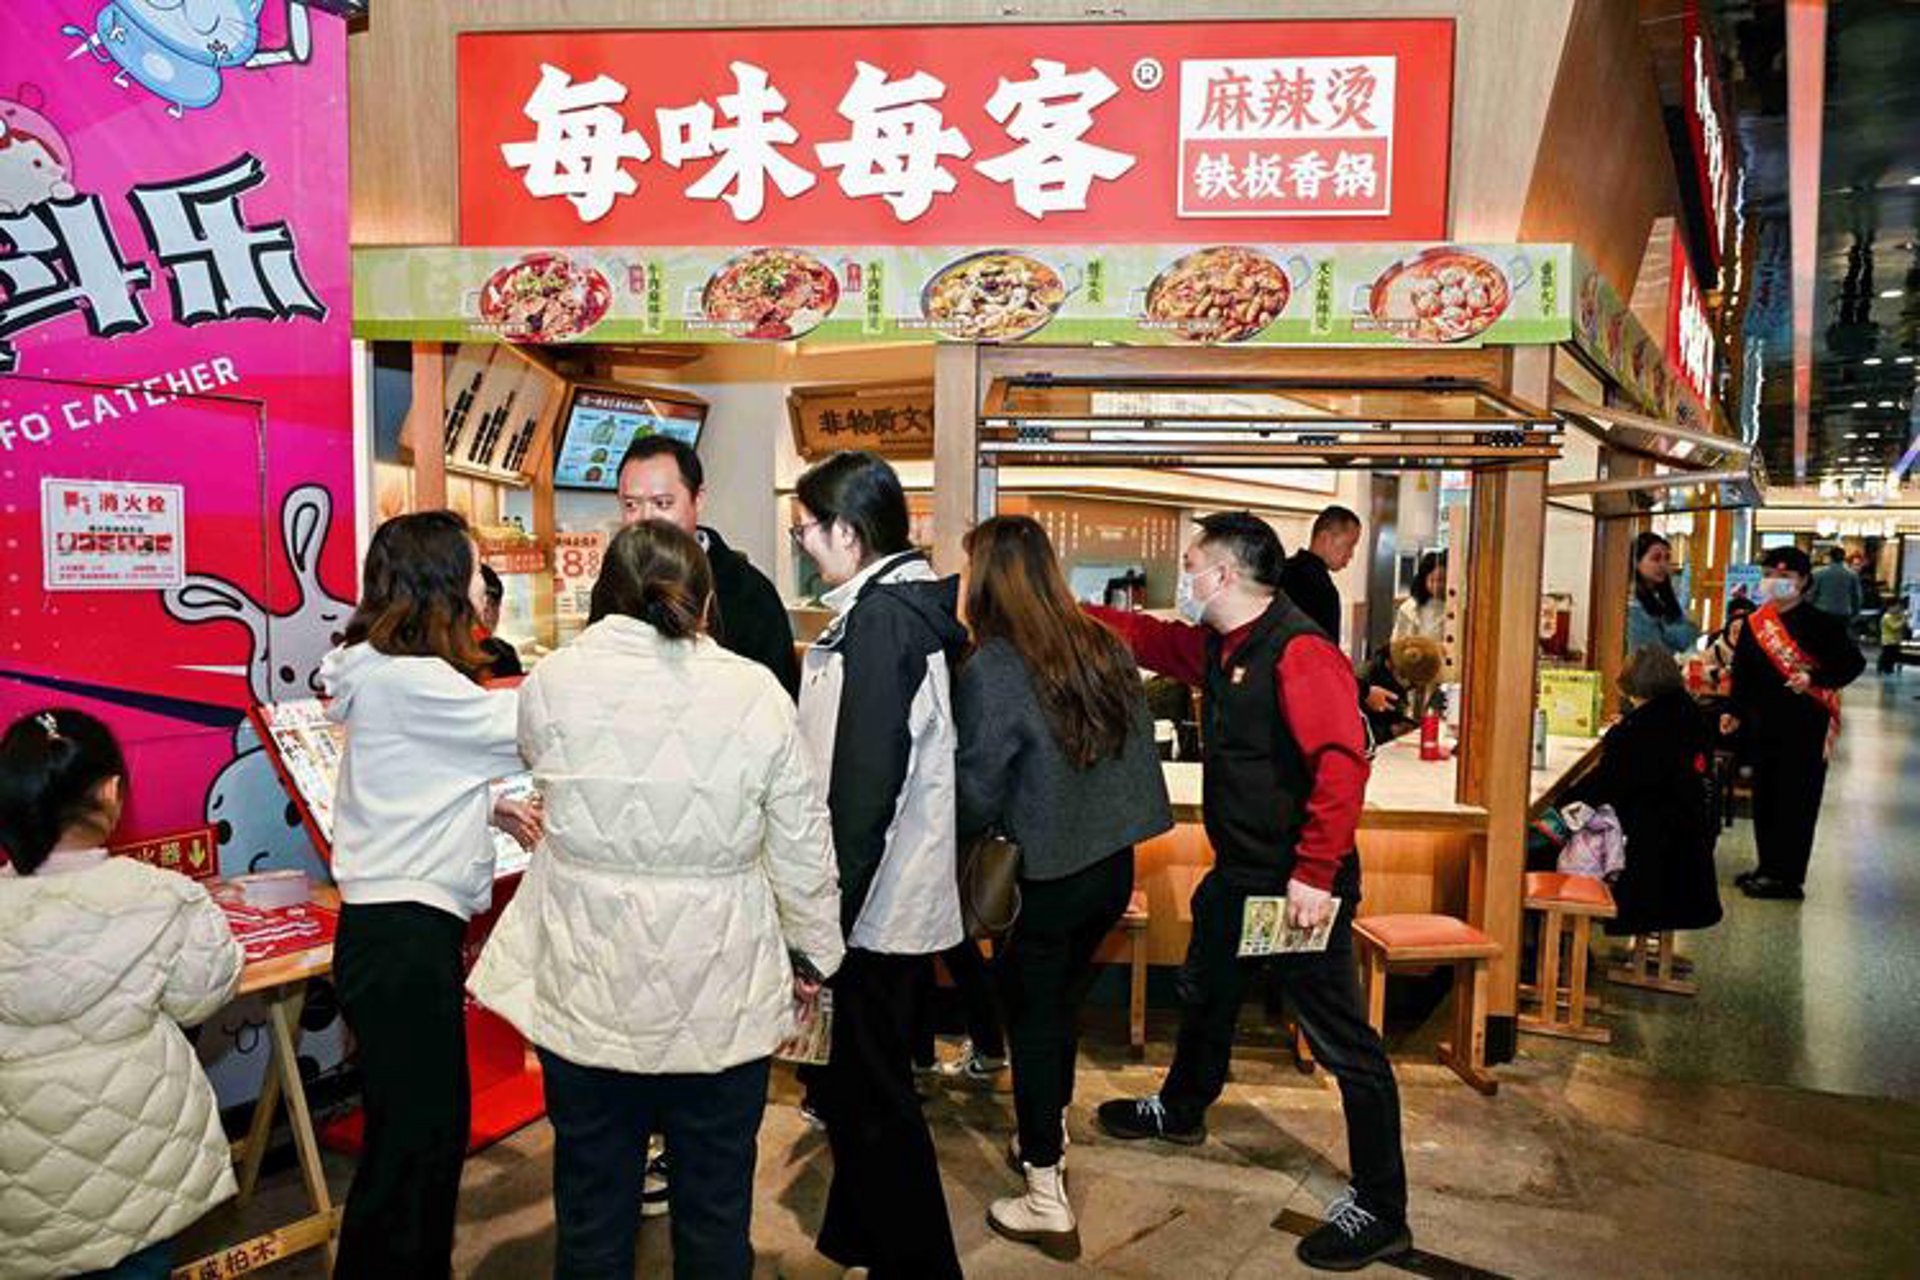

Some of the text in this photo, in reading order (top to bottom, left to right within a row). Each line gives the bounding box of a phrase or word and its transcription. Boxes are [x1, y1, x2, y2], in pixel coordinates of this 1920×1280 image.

[1196, 66, 1378, 130] 麻辣烫
[501, 58, 1136, 222] 每味每客
[1194, 150, 1377, 199] 铁板香锅
[61, 357, 239, 431] CATCHER
[98, 492, 165, 513] 消火栓
